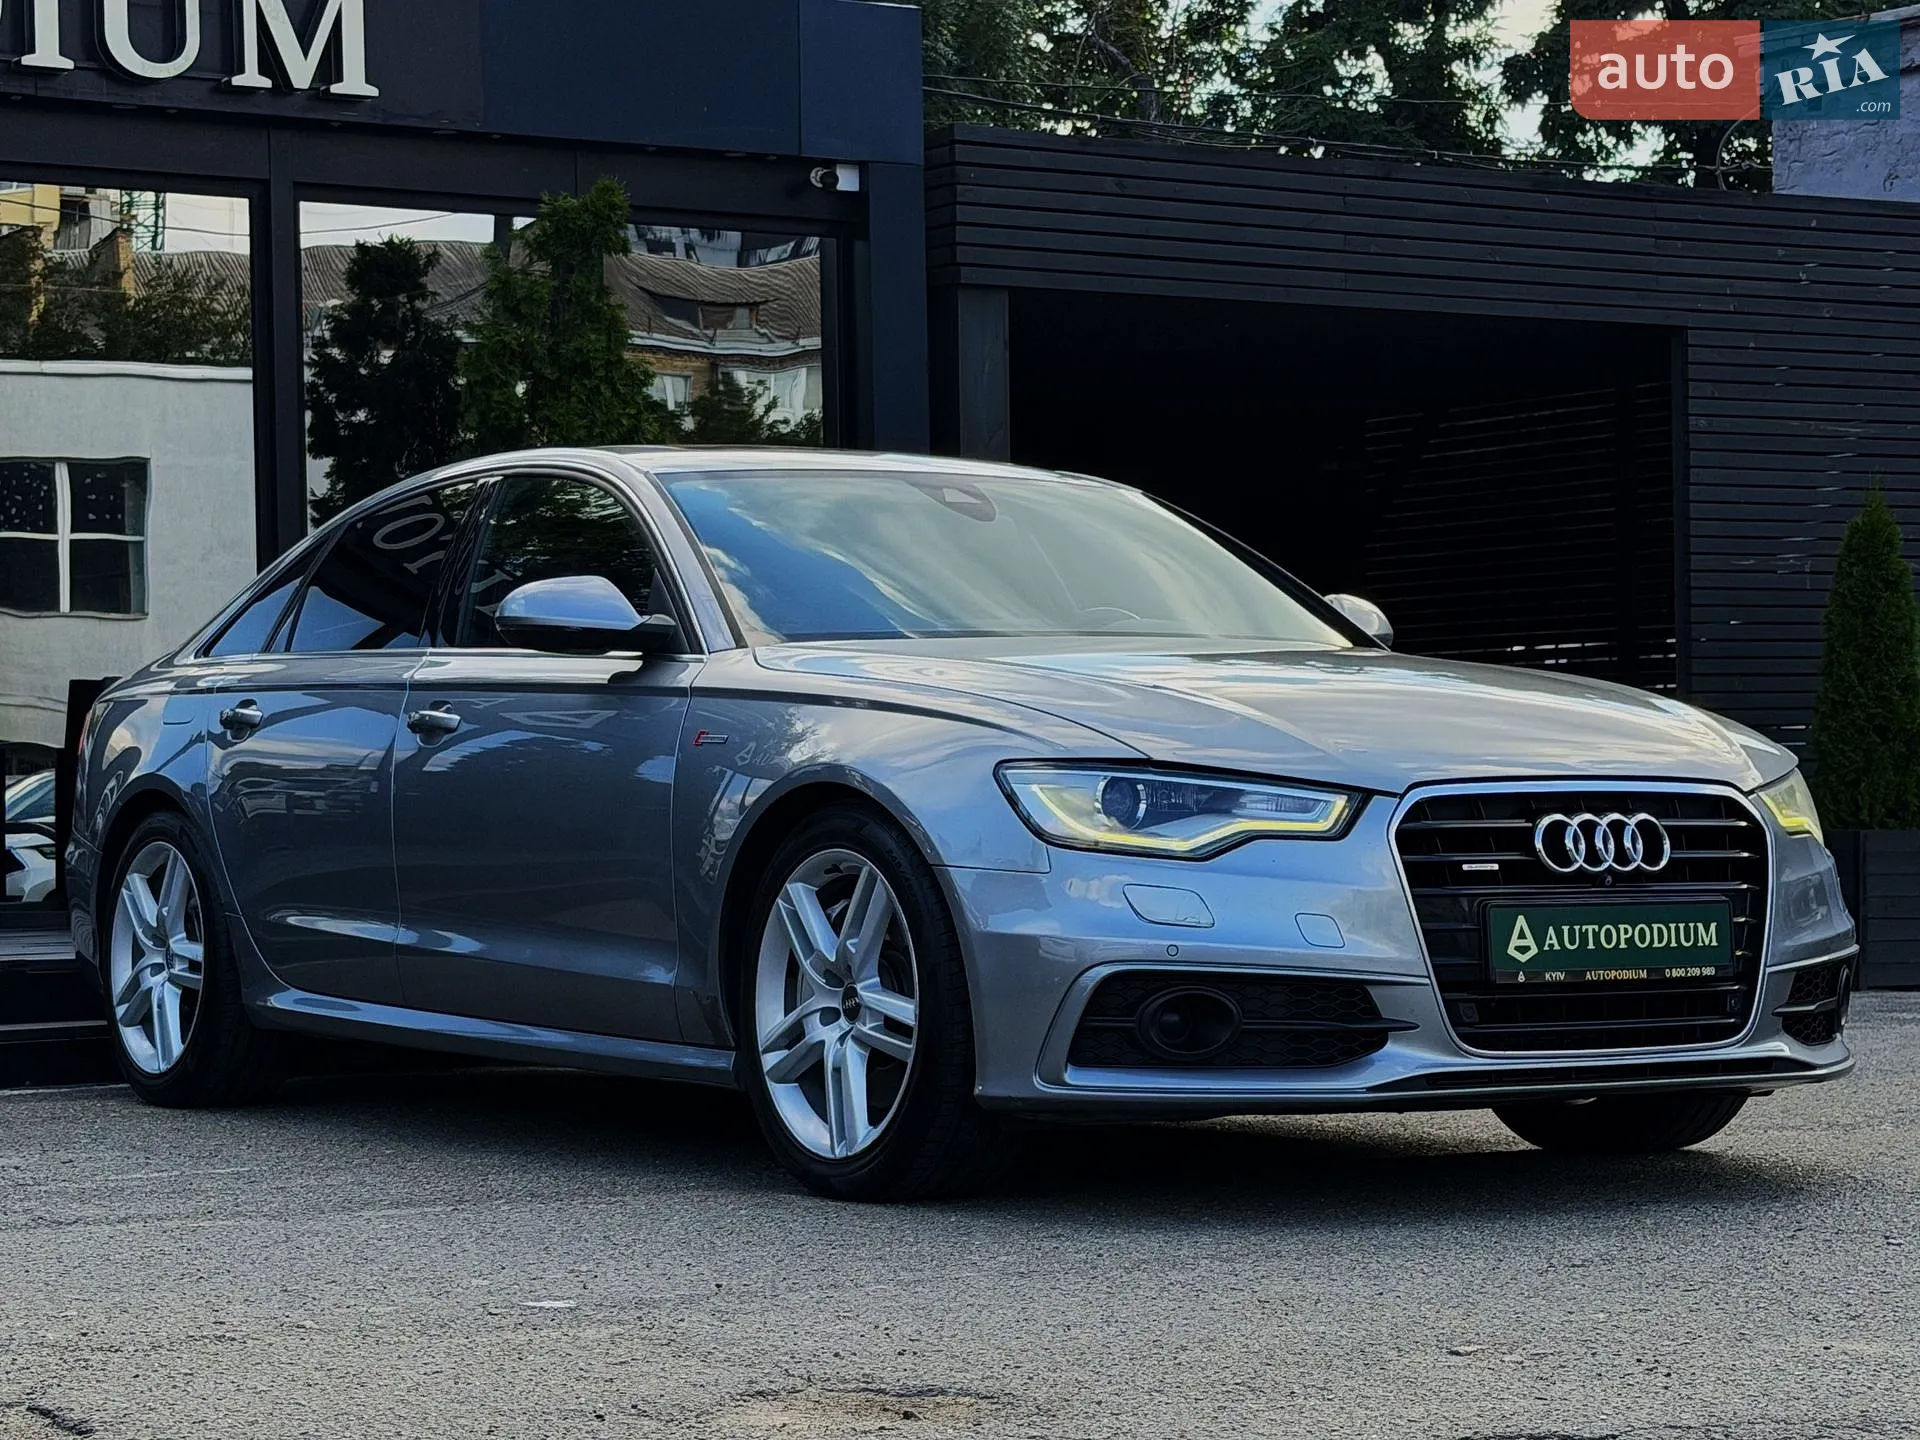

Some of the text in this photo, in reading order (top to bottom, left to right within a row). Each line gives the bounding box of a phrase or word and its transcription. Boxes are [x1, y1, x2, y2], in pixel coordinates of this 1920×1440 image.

[0, 0, 379, 96] IUM
[1543, 922, 1718, 950] AUTOPODIUM
[1545, 971, 1565, 981] KYIV
[1585, 969, 1647, 980] AUTOPODIUM
[1665, 968, 1671, 978] 0
[1686, 967, 1701, 977] 209
